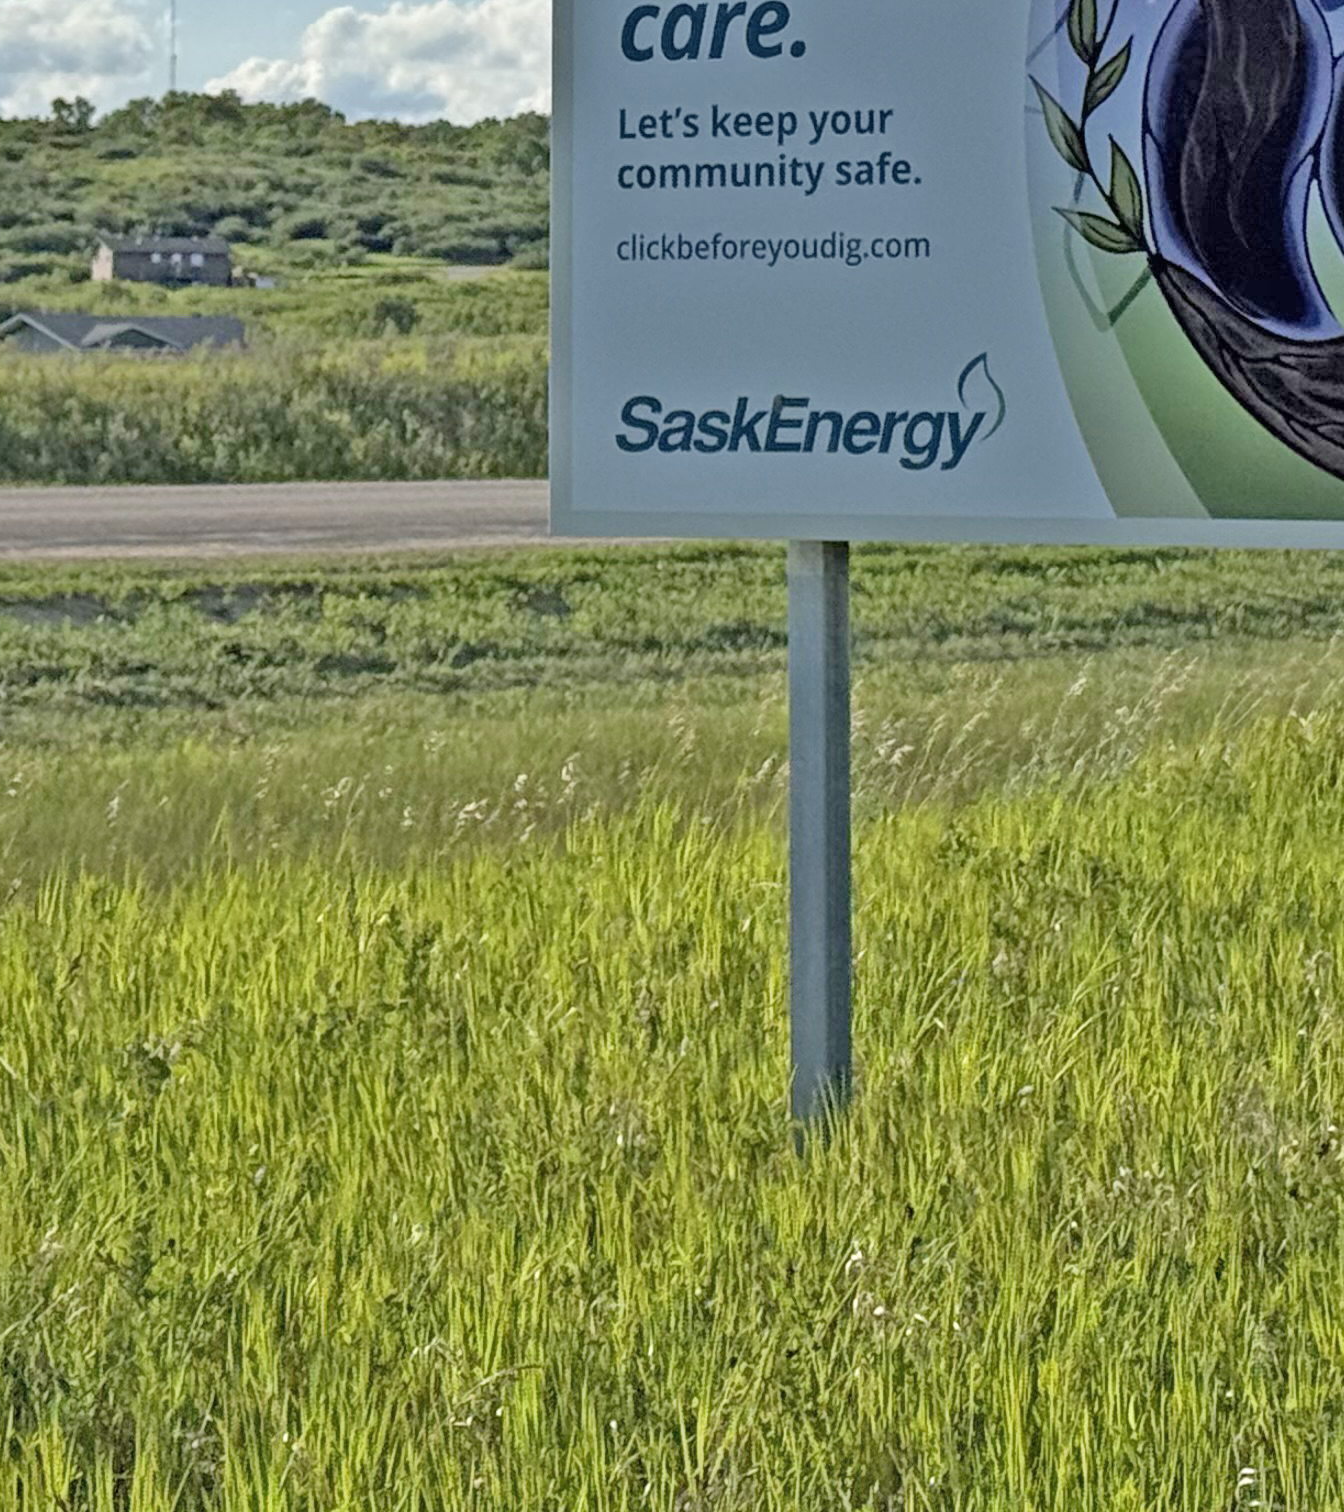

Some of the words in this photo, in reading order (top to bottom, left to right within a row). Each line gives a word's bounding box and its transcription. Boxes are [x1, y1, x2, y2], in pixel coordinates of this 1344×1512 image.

[620, 0, 807, 63] care.
[619, 106, 700, 140] Let's
[711, 104, 798, 146] keep
[808, 105, 894, 144] your
[617, 154, 826, 196] community
[835, 152, 922, 186] safe.
[616, 231, 931, 268] clickbeforeyoudig.com
[615, 394, 987, 471] SaskEnergy
